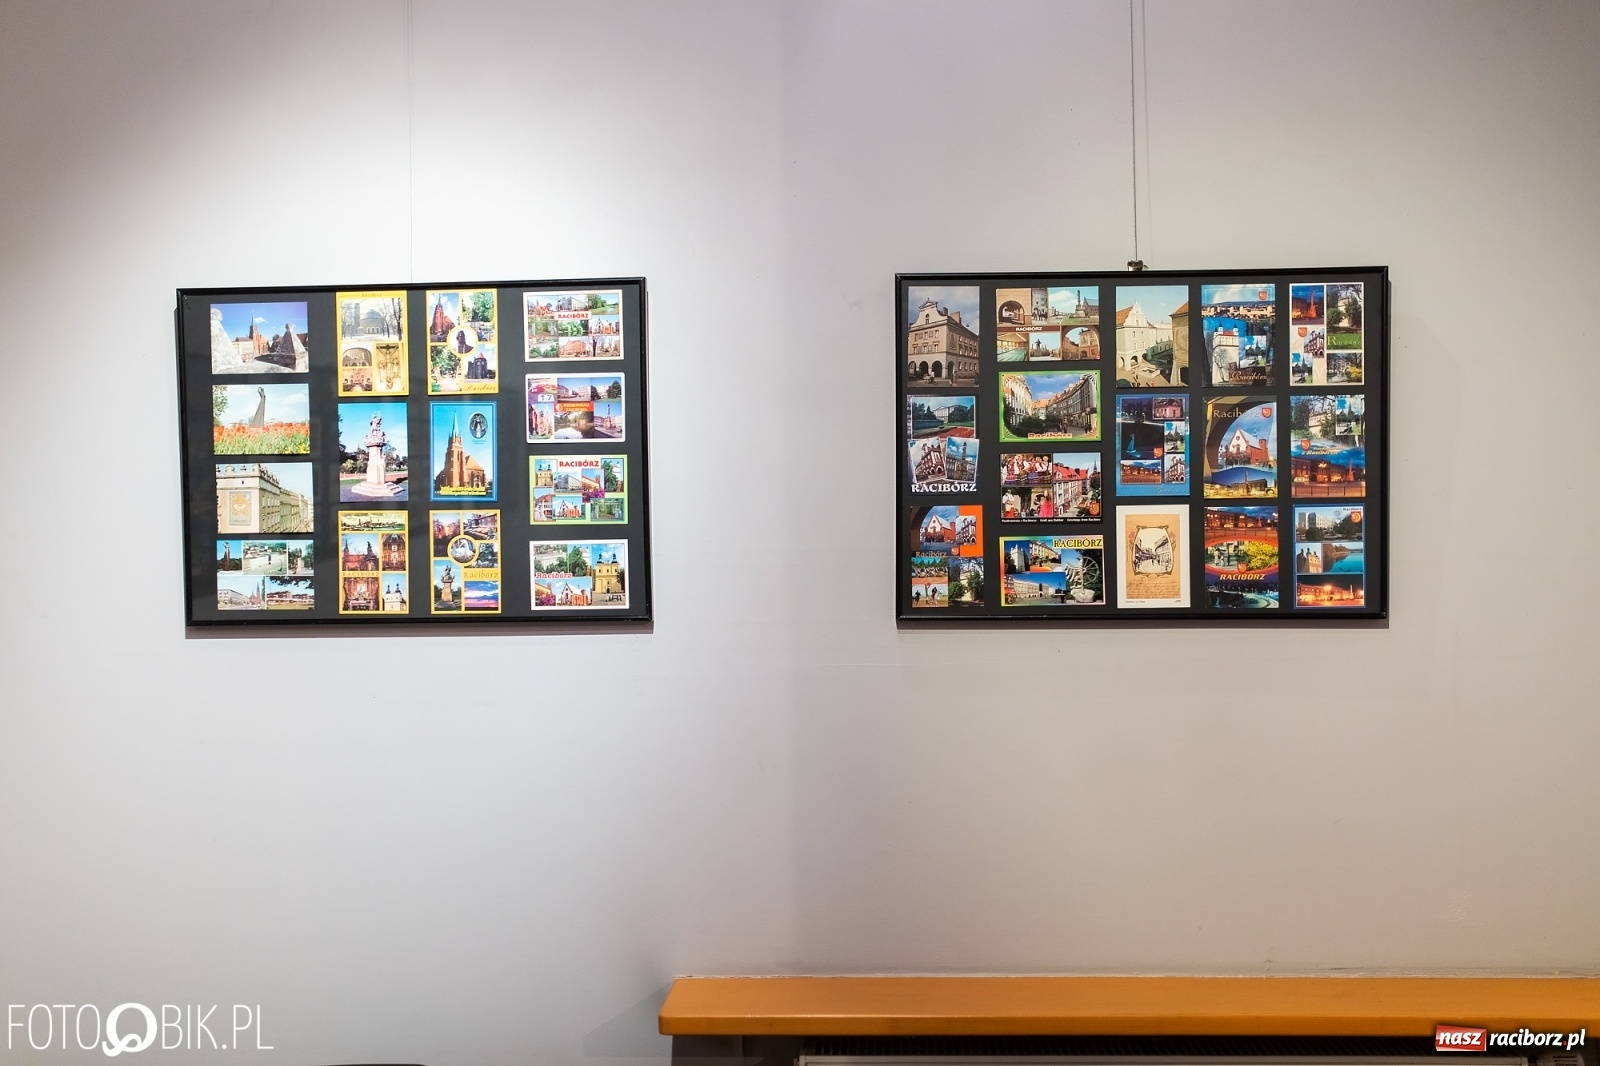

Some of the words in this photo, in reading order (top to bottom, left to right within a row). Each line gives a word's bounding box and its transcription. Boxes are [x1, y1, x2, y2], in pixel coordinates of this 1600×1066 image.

[557, 312, 590, 320] RACIBÓRZ
[1213, 407, 1260, 418] Racibórz
[558, 459, 600, 468] RACIBÓRZ
[910, 482, 978, 493] RACIBÓRZ
[1053, 537, 1103, 548] RACIBÓRZ
[535, 572, 573, 580] Racibórz
[1219, 572, 1266, 581] RACIBÓRZ
